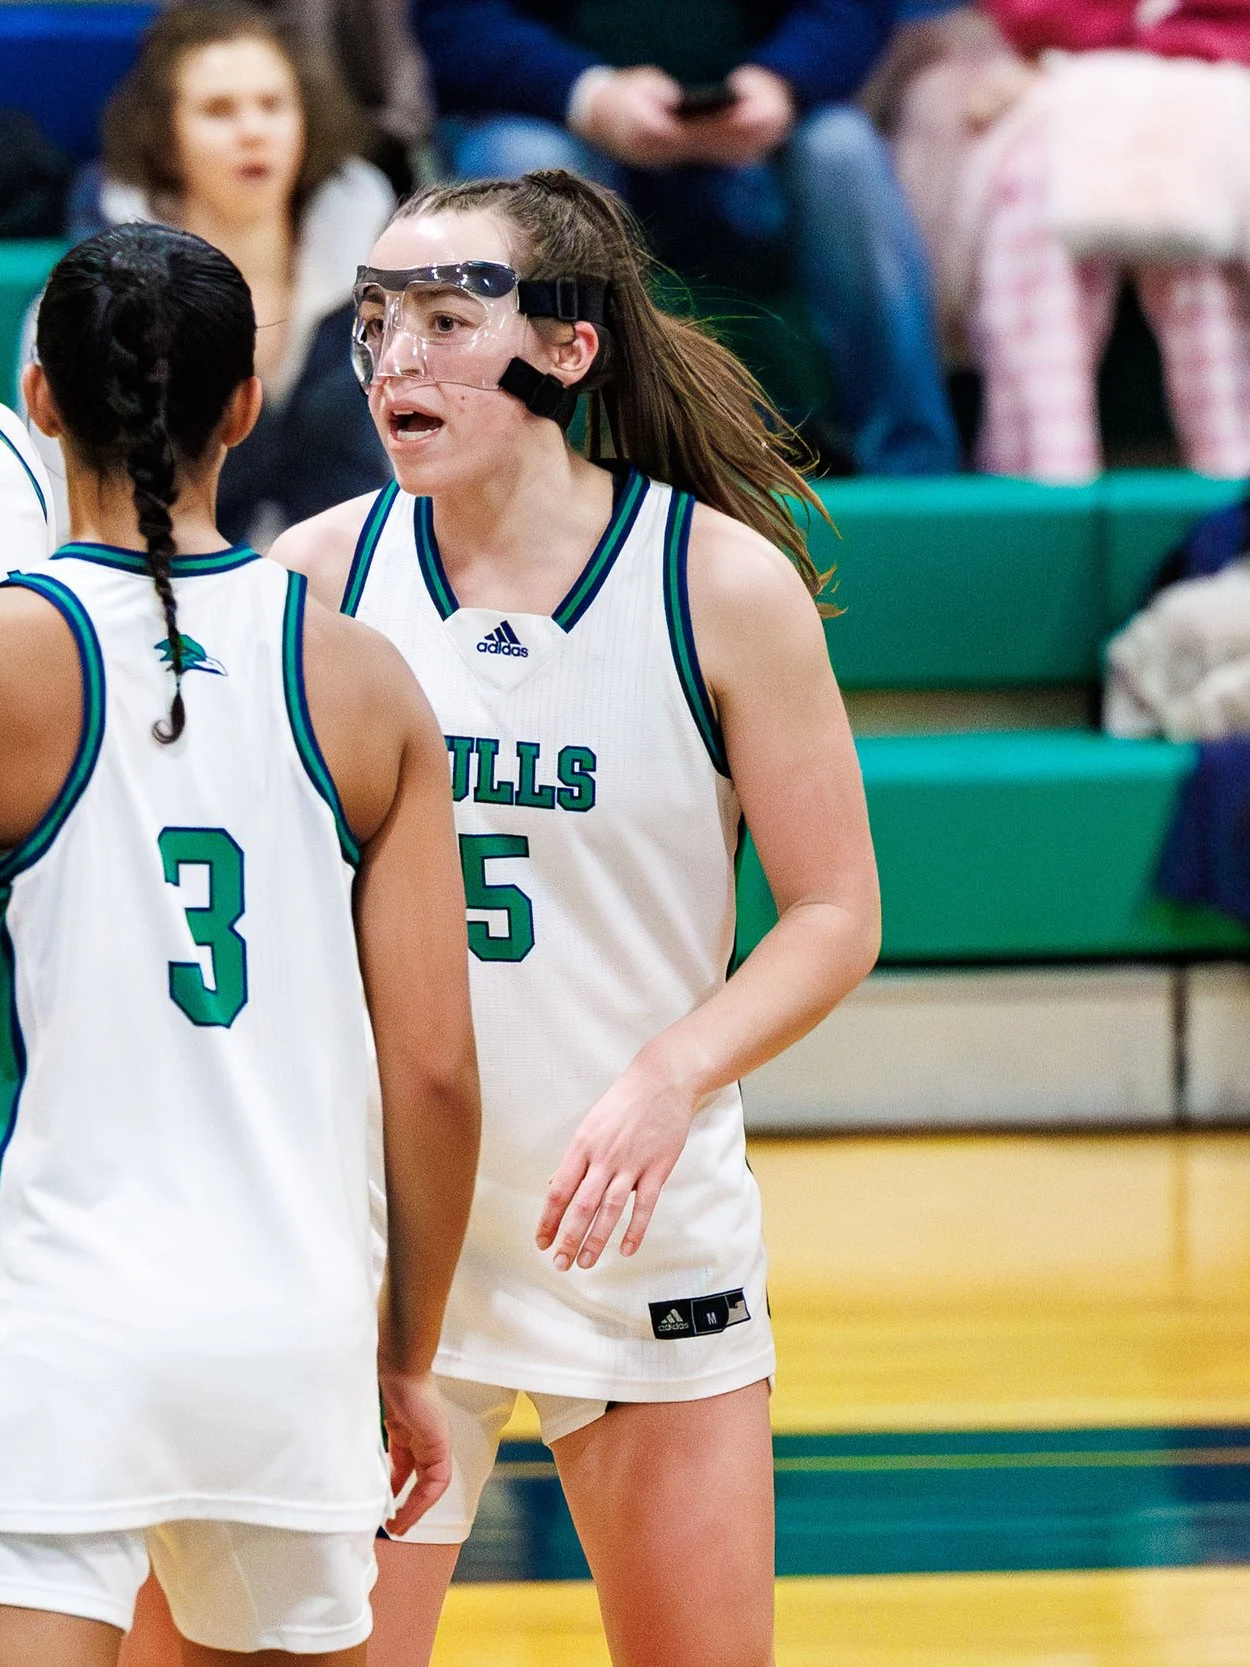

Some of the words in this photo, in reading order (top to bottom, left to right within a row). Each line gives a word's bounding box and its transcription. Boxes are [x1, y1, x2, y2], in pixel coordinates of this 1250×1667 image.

[476, 640, 529, 658] adidas
[444, 735, 597, 812] ULLS
[458, 833, 535, 962] 5
[157, 826, 249, 1029] 3
[657, 1321, 689, 1332] adidas
[706, 1311, 717, 1325] M
